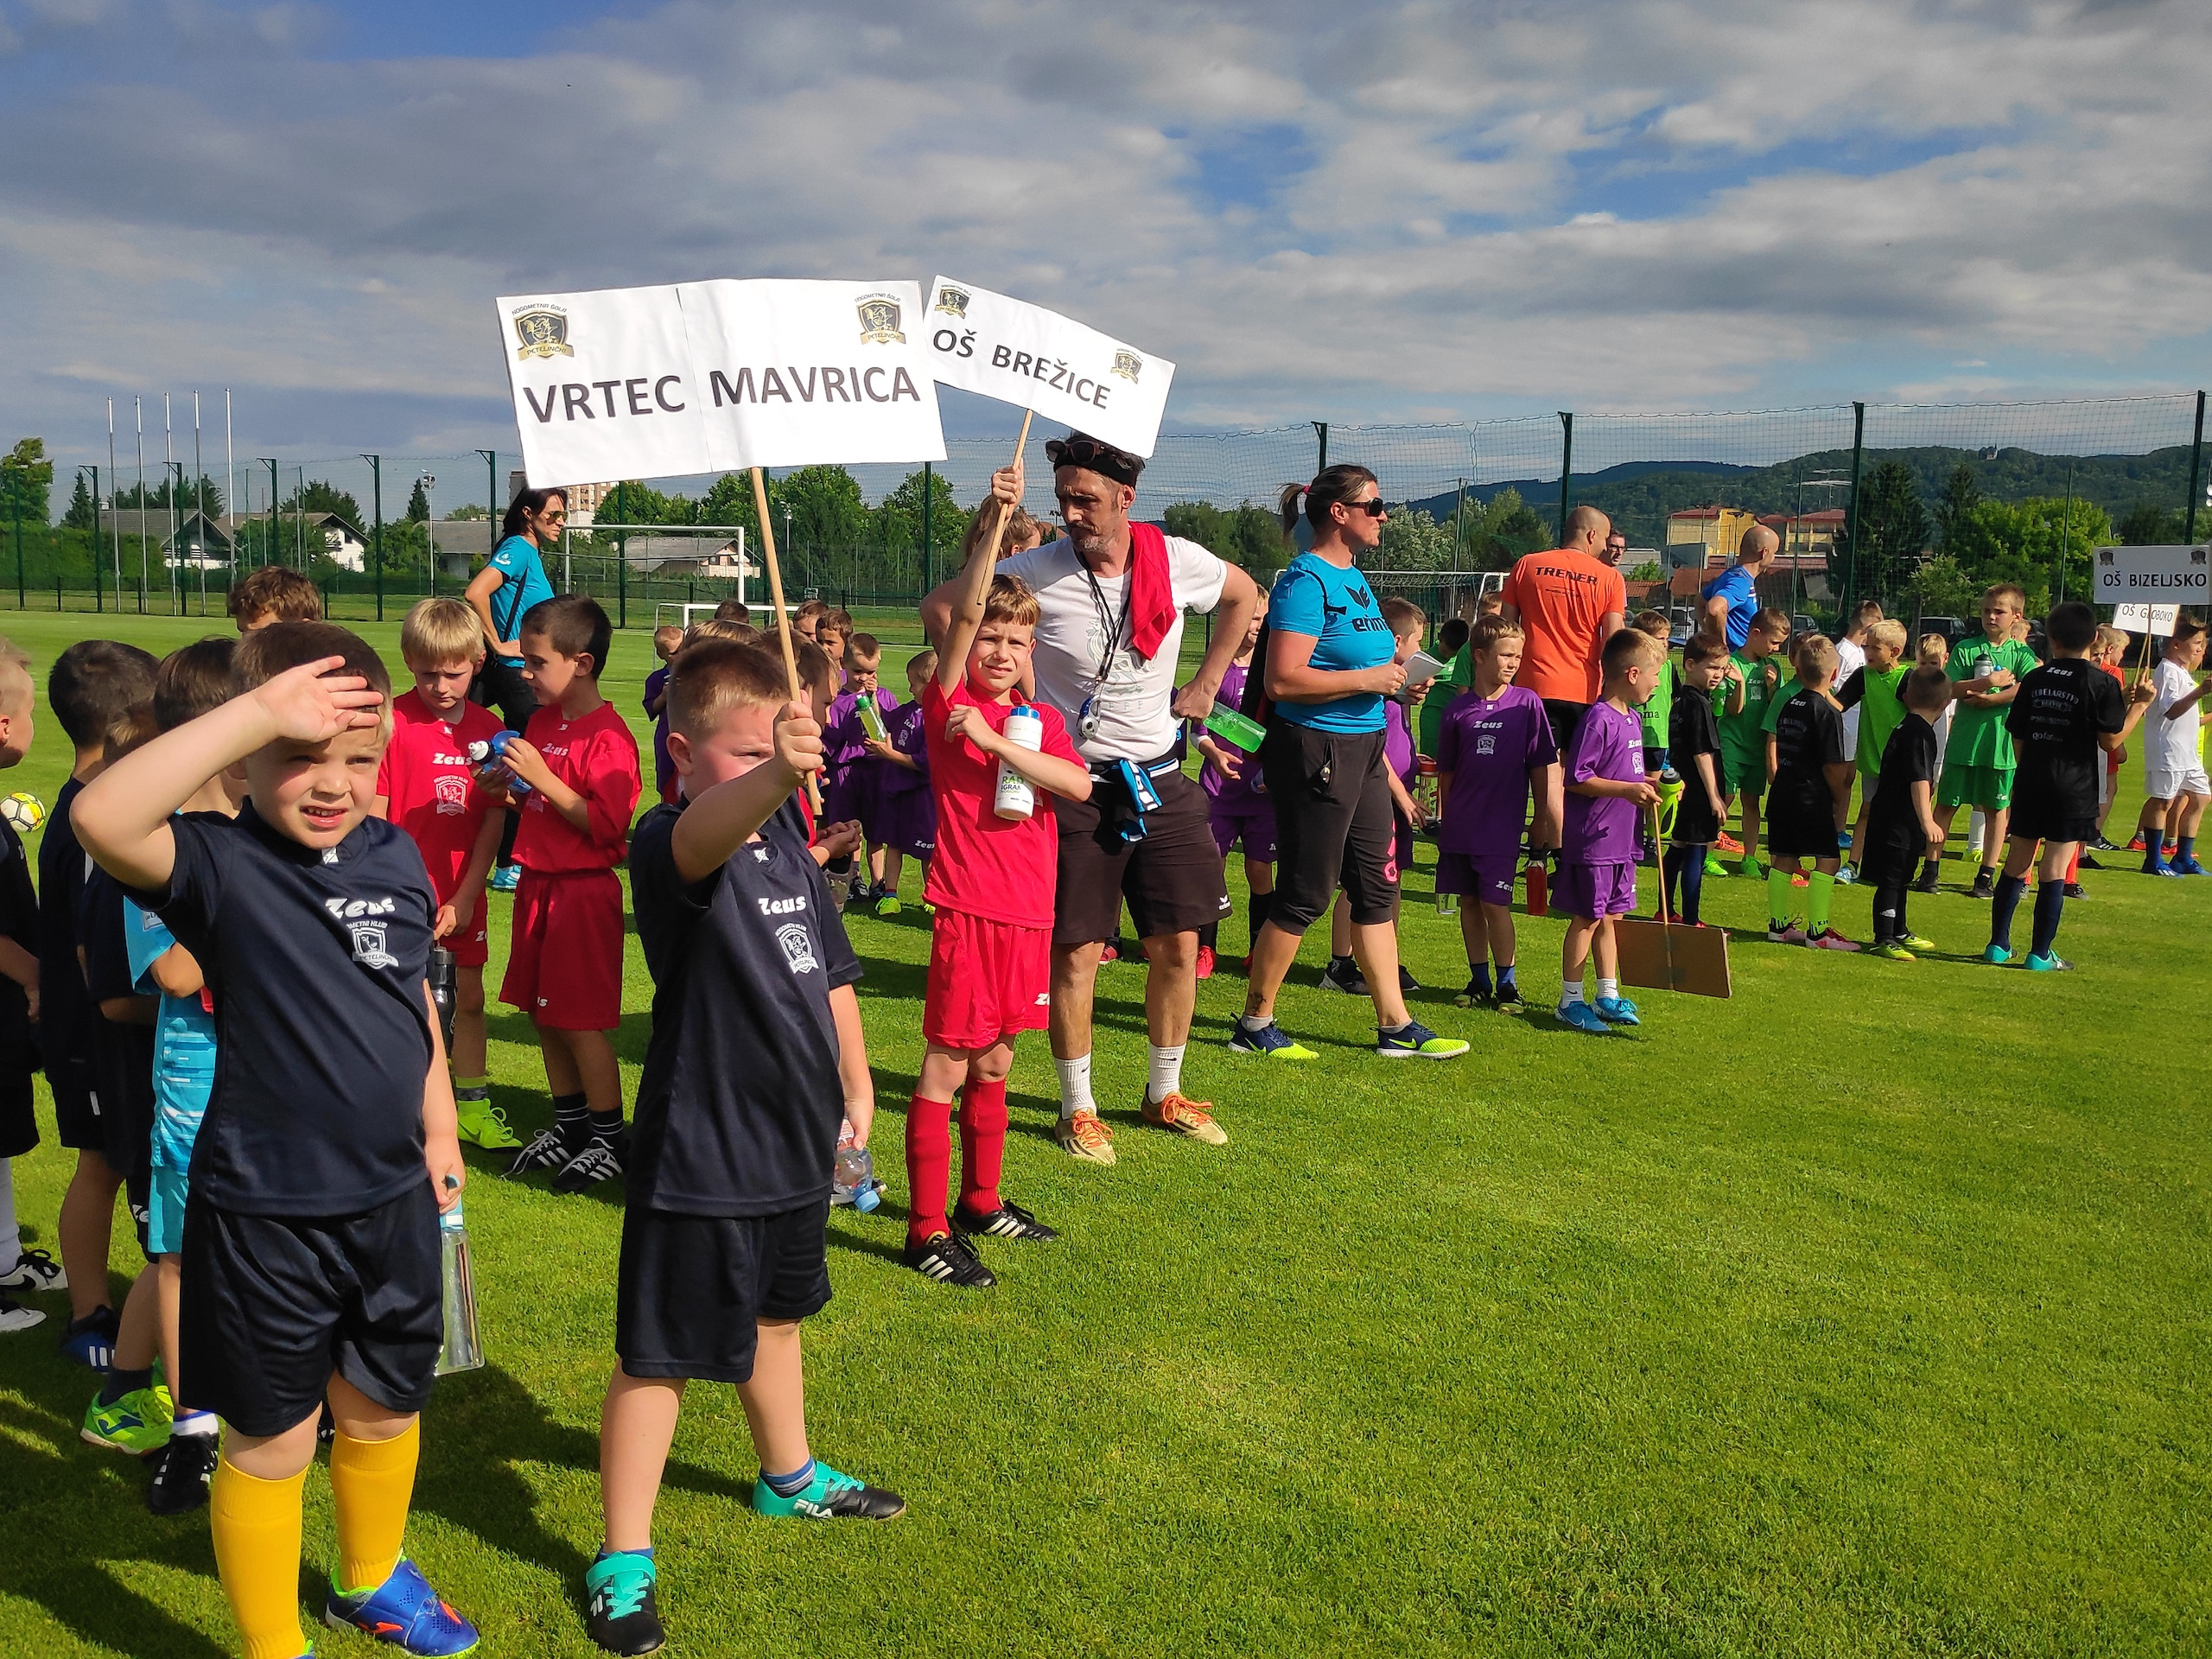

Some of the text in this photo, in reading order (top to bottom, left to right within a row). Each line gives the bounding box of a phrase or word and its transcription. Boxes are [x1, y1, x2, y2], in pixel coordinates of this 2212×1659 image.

[933, 328, 1110, 410] OŠ BREŽICE
[523, 366, 921, 423] VRTEC MAVRICA
[1535, 567, 1598, 584] TRENER
[2103, 570, 2207, 587] OŠ BIZELJSKO
[1351, 613, 1389, 632] erim
[2139, 607, 2173, 622] GOBOKO
[2045, 667, 2074, 677] Zeus
[432, 753, 473, 766] Zeus
[326, 898, 396, 918] Zeus
[759, 896, 806, 915] Zeus
[793, 1498, 833, 1518] FILA
